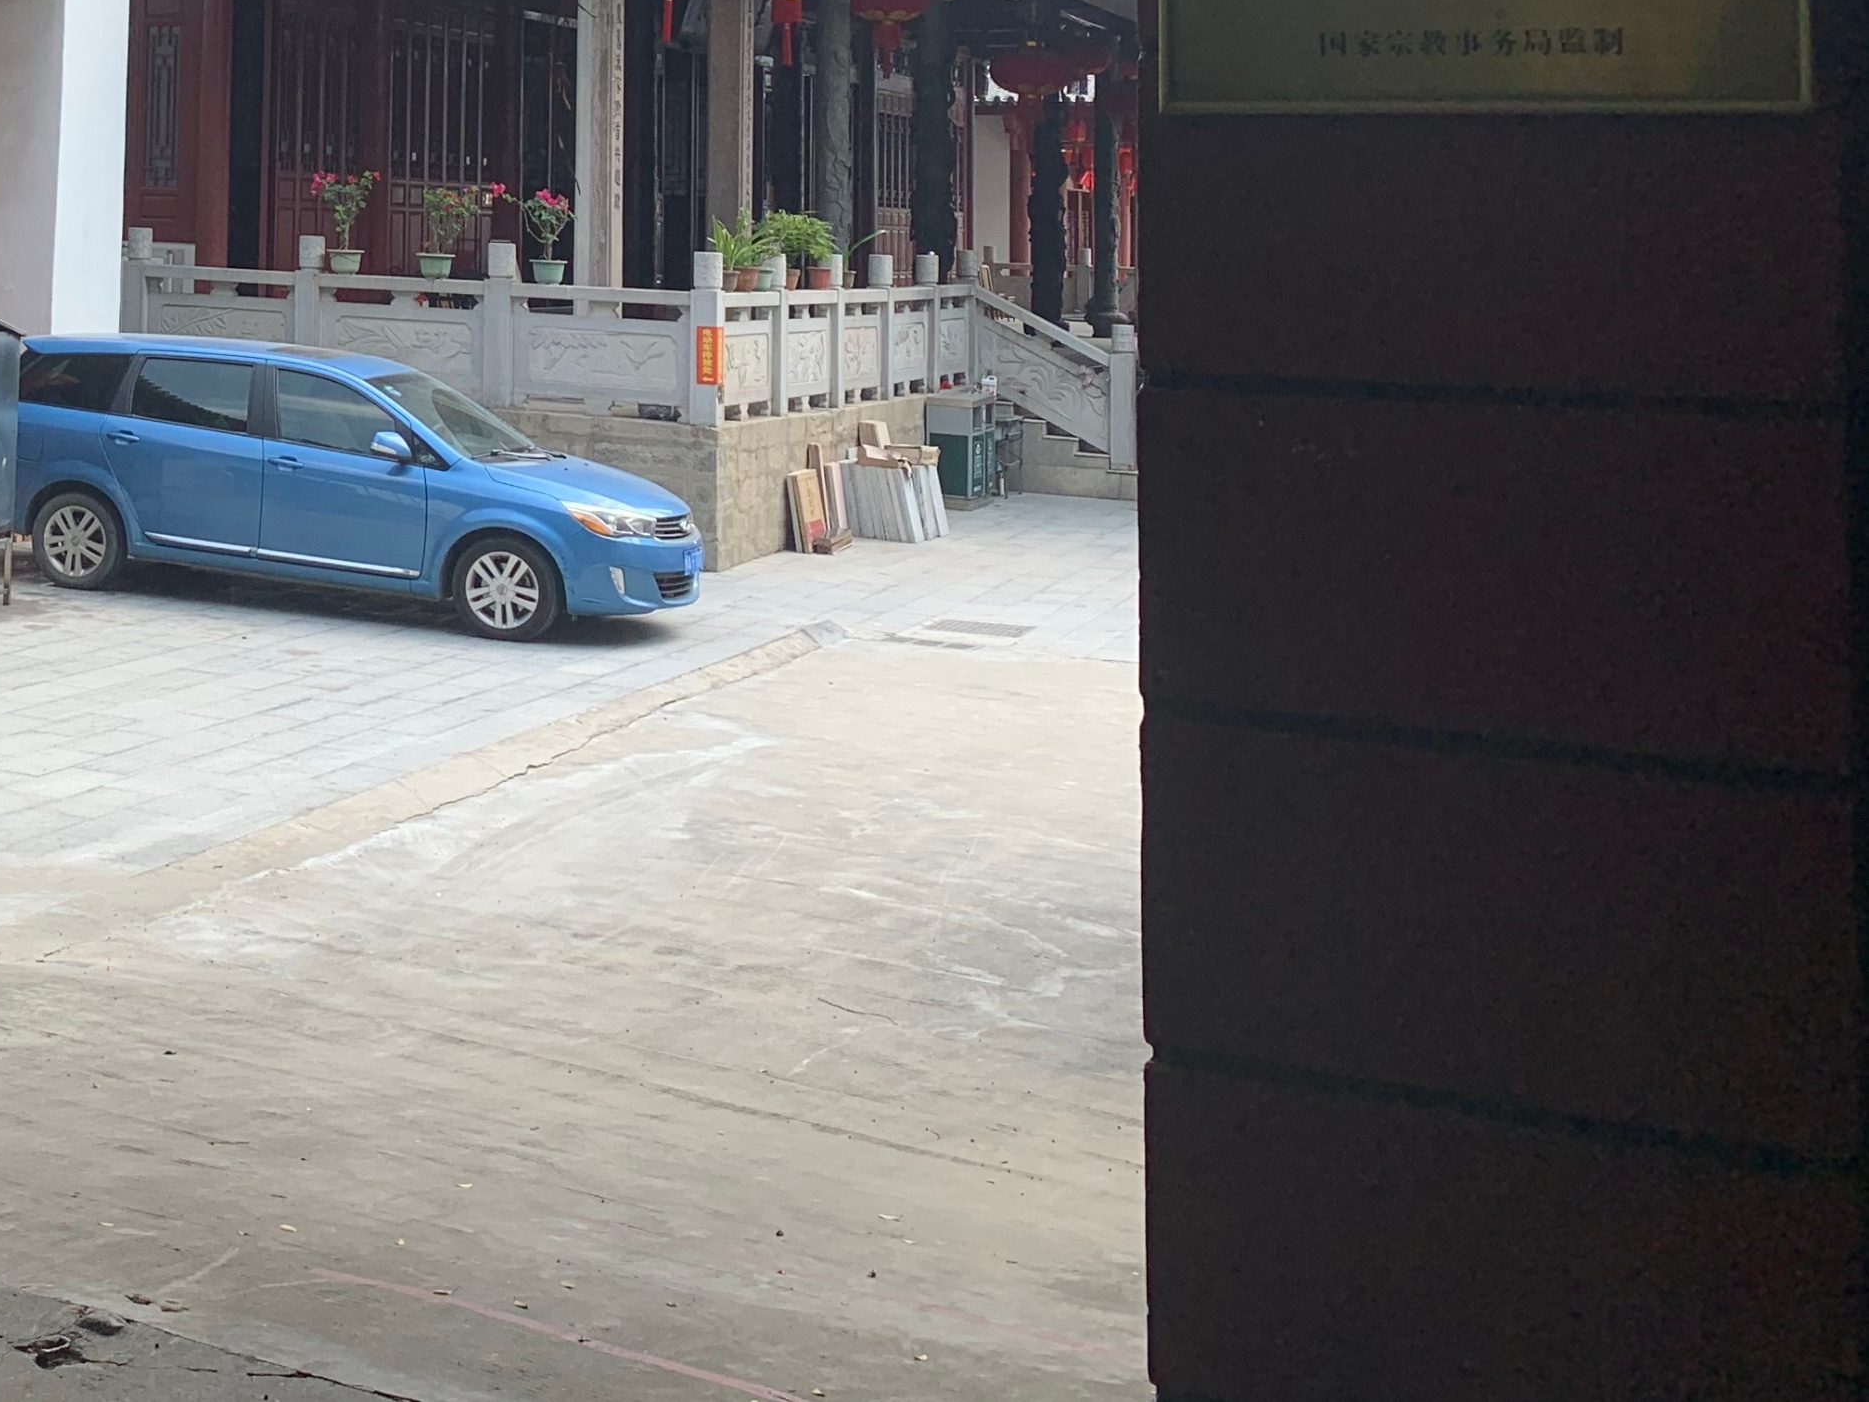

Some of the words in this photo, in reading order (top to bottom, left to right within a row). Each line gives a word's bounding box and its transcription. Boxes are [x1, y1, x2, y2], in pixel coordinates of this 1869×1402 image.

[1318, 26, 1625, 60] 国家宗教事务局监制
